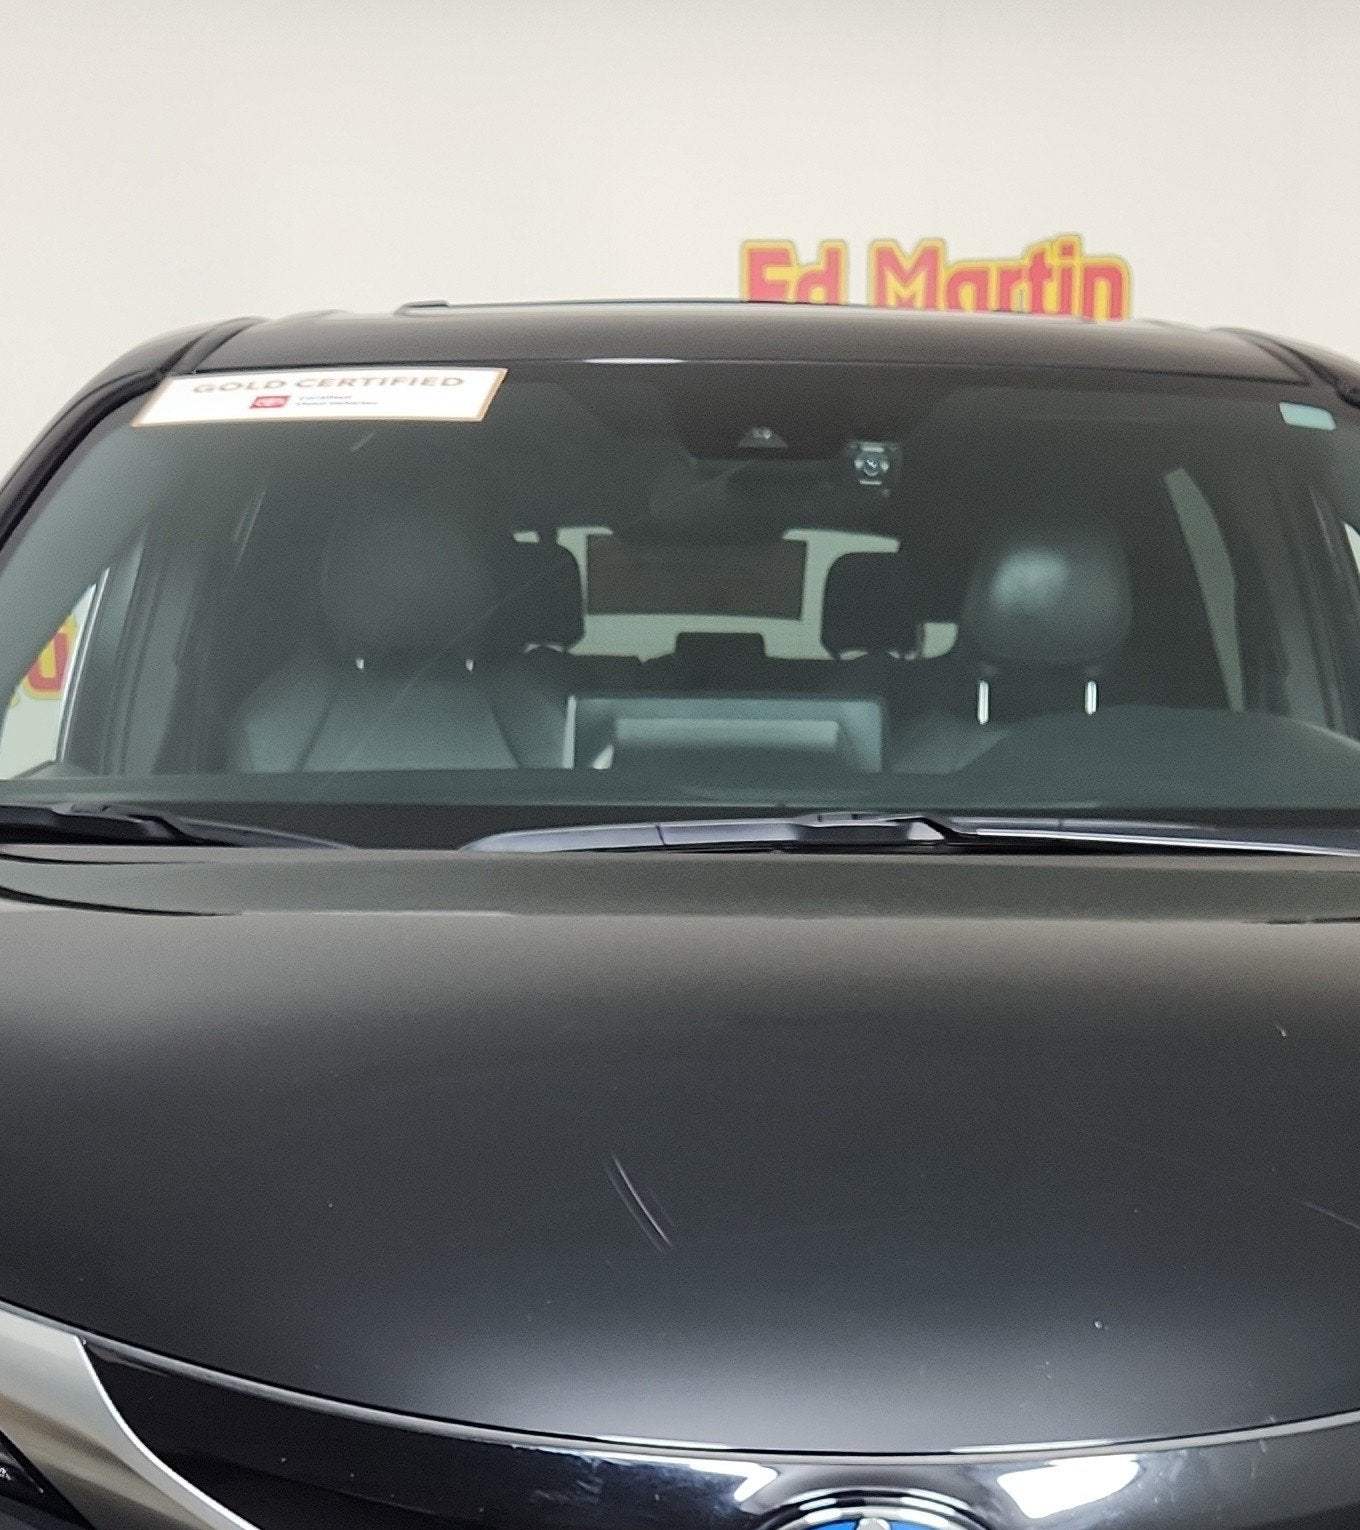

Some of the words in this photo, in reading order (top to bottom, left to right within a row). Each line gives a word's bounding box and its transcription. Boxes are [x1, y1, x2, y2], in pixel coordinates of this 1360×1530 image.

[744, 243, 846, 304] Ed
[871, 239, 1128, 322] Martin
[192, 379, 287, 395] GOLD
[294, 375, 466, 389] CERTIFIED
